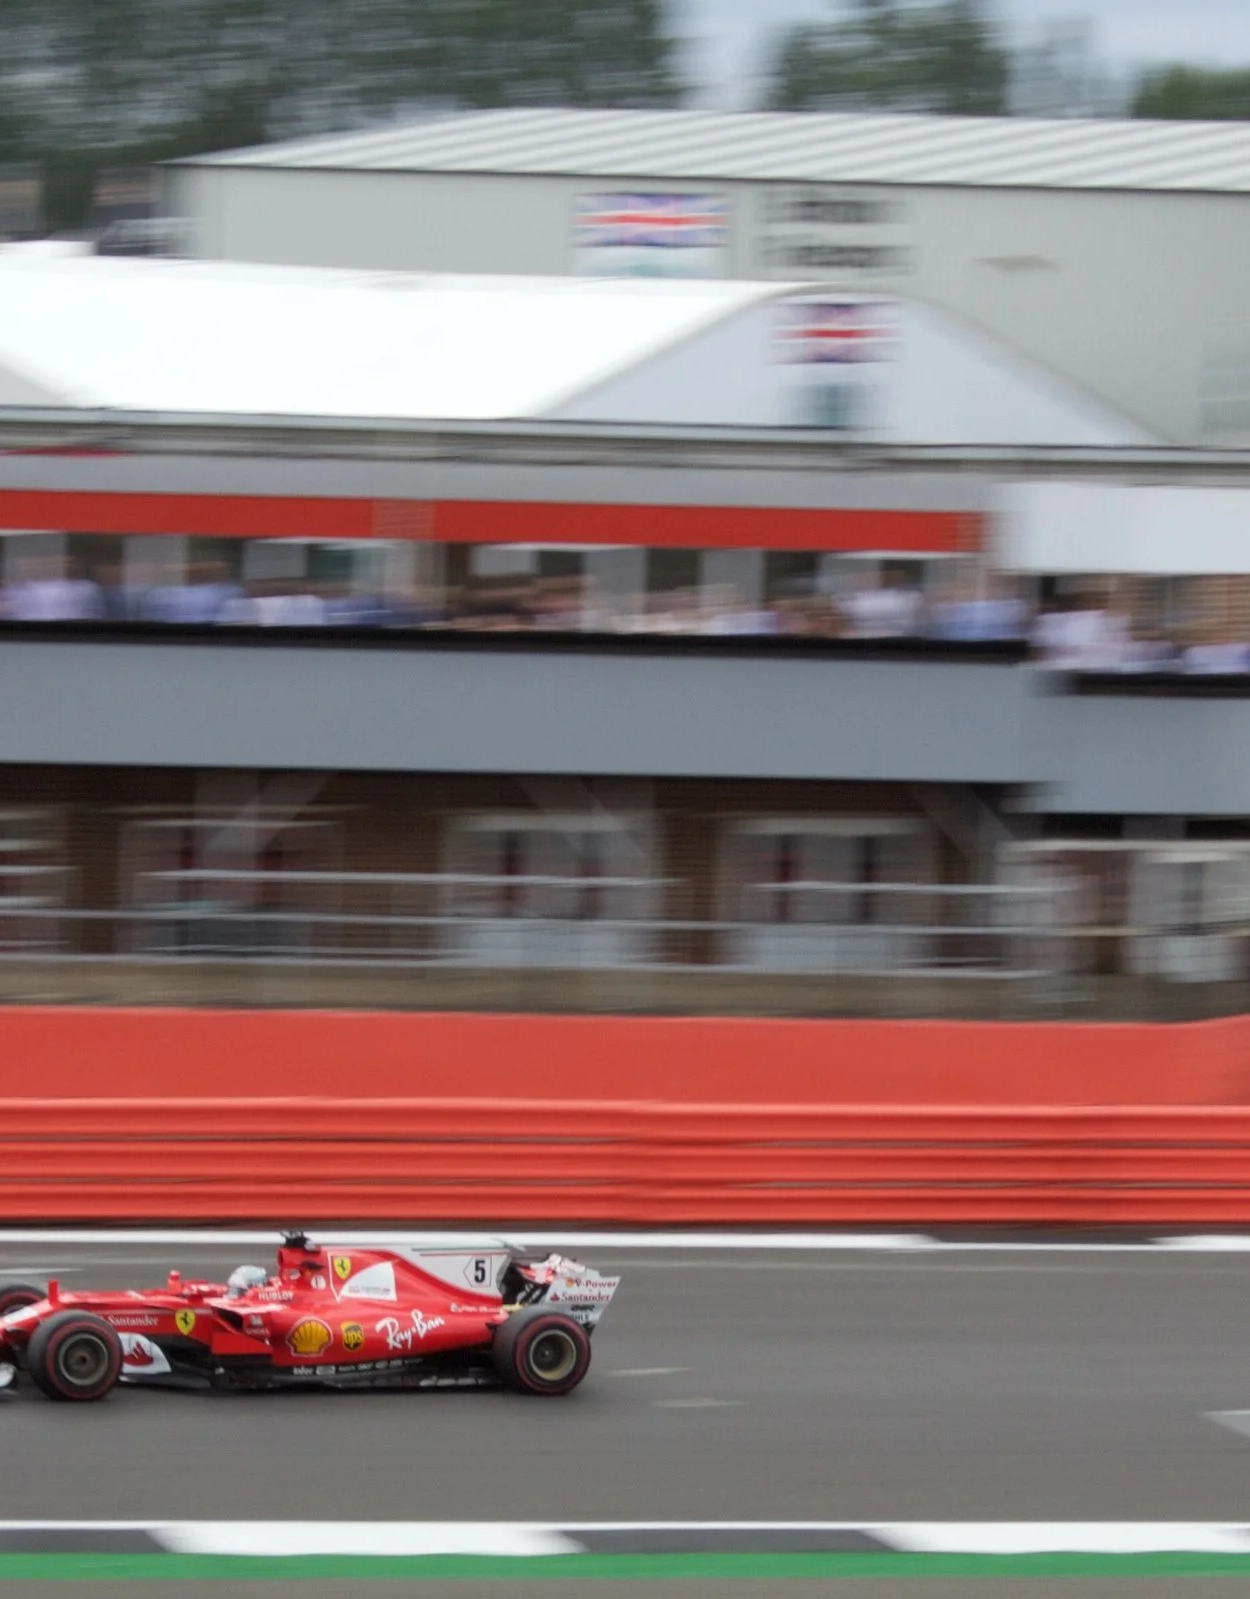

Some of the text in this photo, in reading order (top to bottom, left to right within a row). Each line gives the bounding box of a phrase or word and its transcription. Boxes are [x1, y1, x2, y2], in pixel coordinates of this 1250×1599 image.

[474, 1259, 486, 1283] 5
[258, 1291, 294, 1301] HUBLOT
[562, 1291, 610, 1302] Santander
[108, 1314, 159, 1327] Santander
[375, 1309, 446, 1350] Ray-Ban
